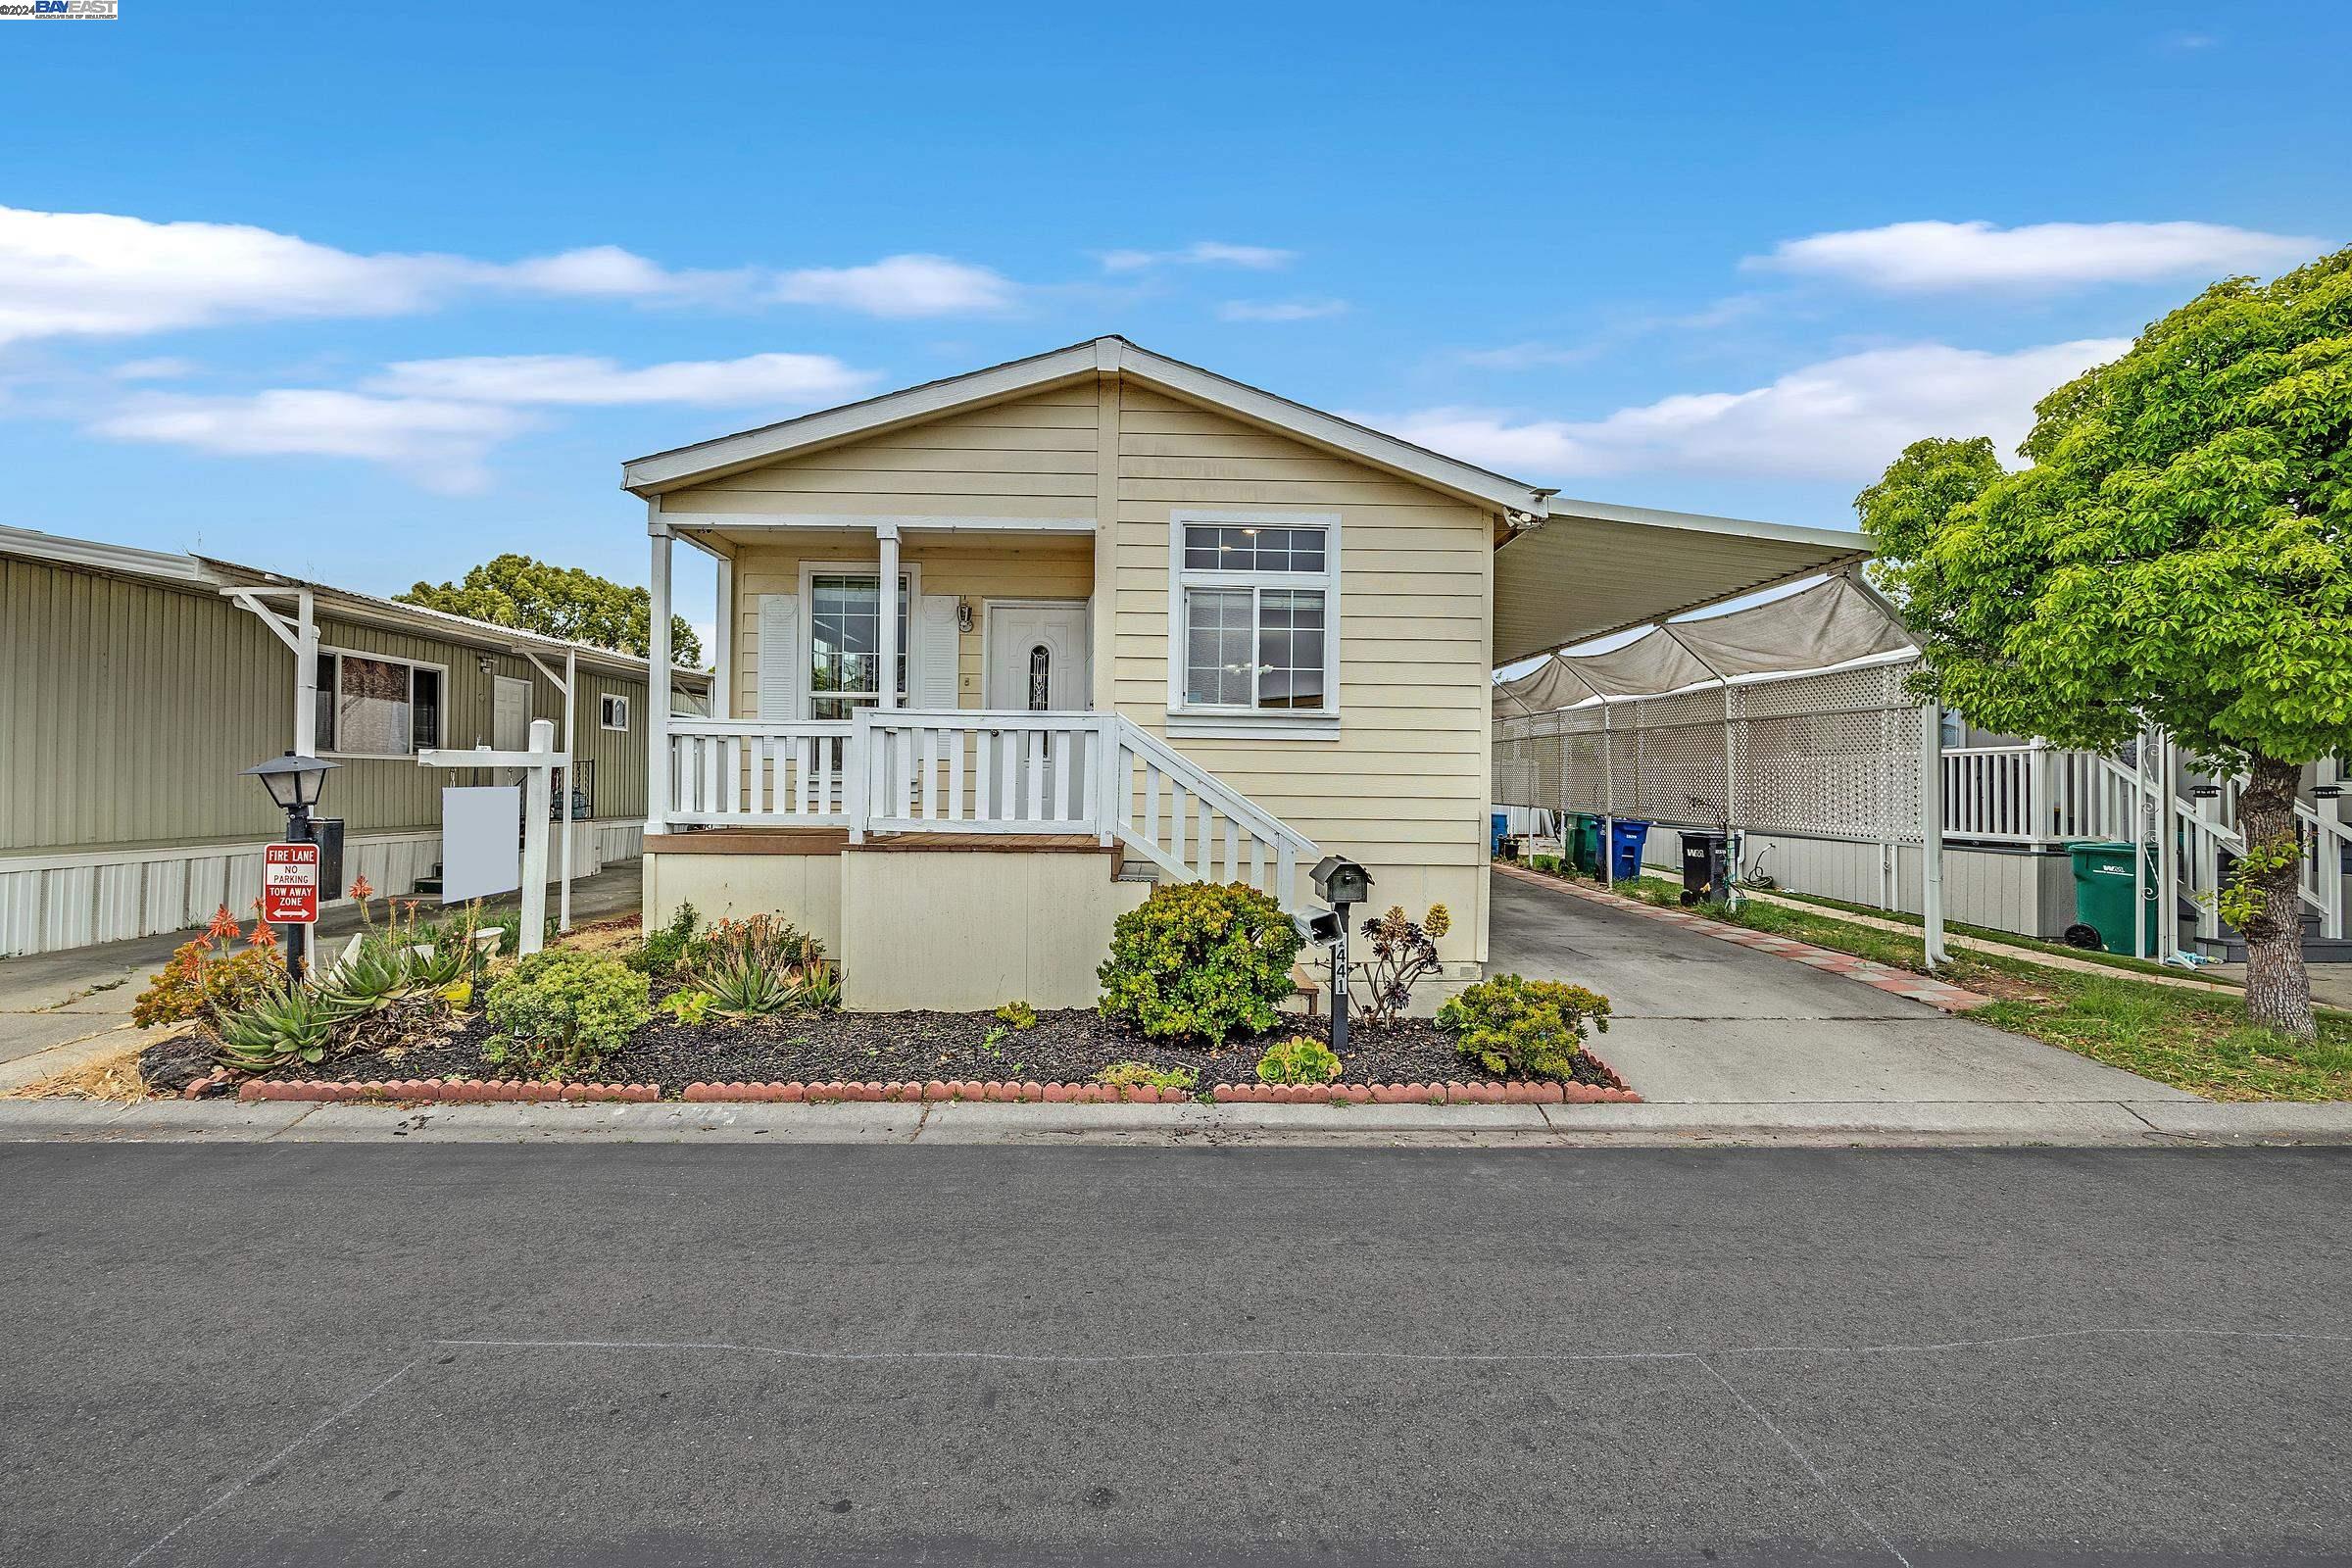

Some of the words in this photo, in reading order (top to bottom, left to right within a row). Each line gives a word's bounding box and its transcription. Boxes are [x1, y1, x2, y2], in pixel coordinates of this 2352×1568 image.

[269, 850, 289, 861] FIRE
[292, 851, 315, 862] LANE
[284, 865, 298, 874] NO
[273, 875, 309, 884] PARKING
[270, 887, 287, 897] TOW
[289, 887, 313, 897] AWAY
[279, 897, 303, 906] ZONE
